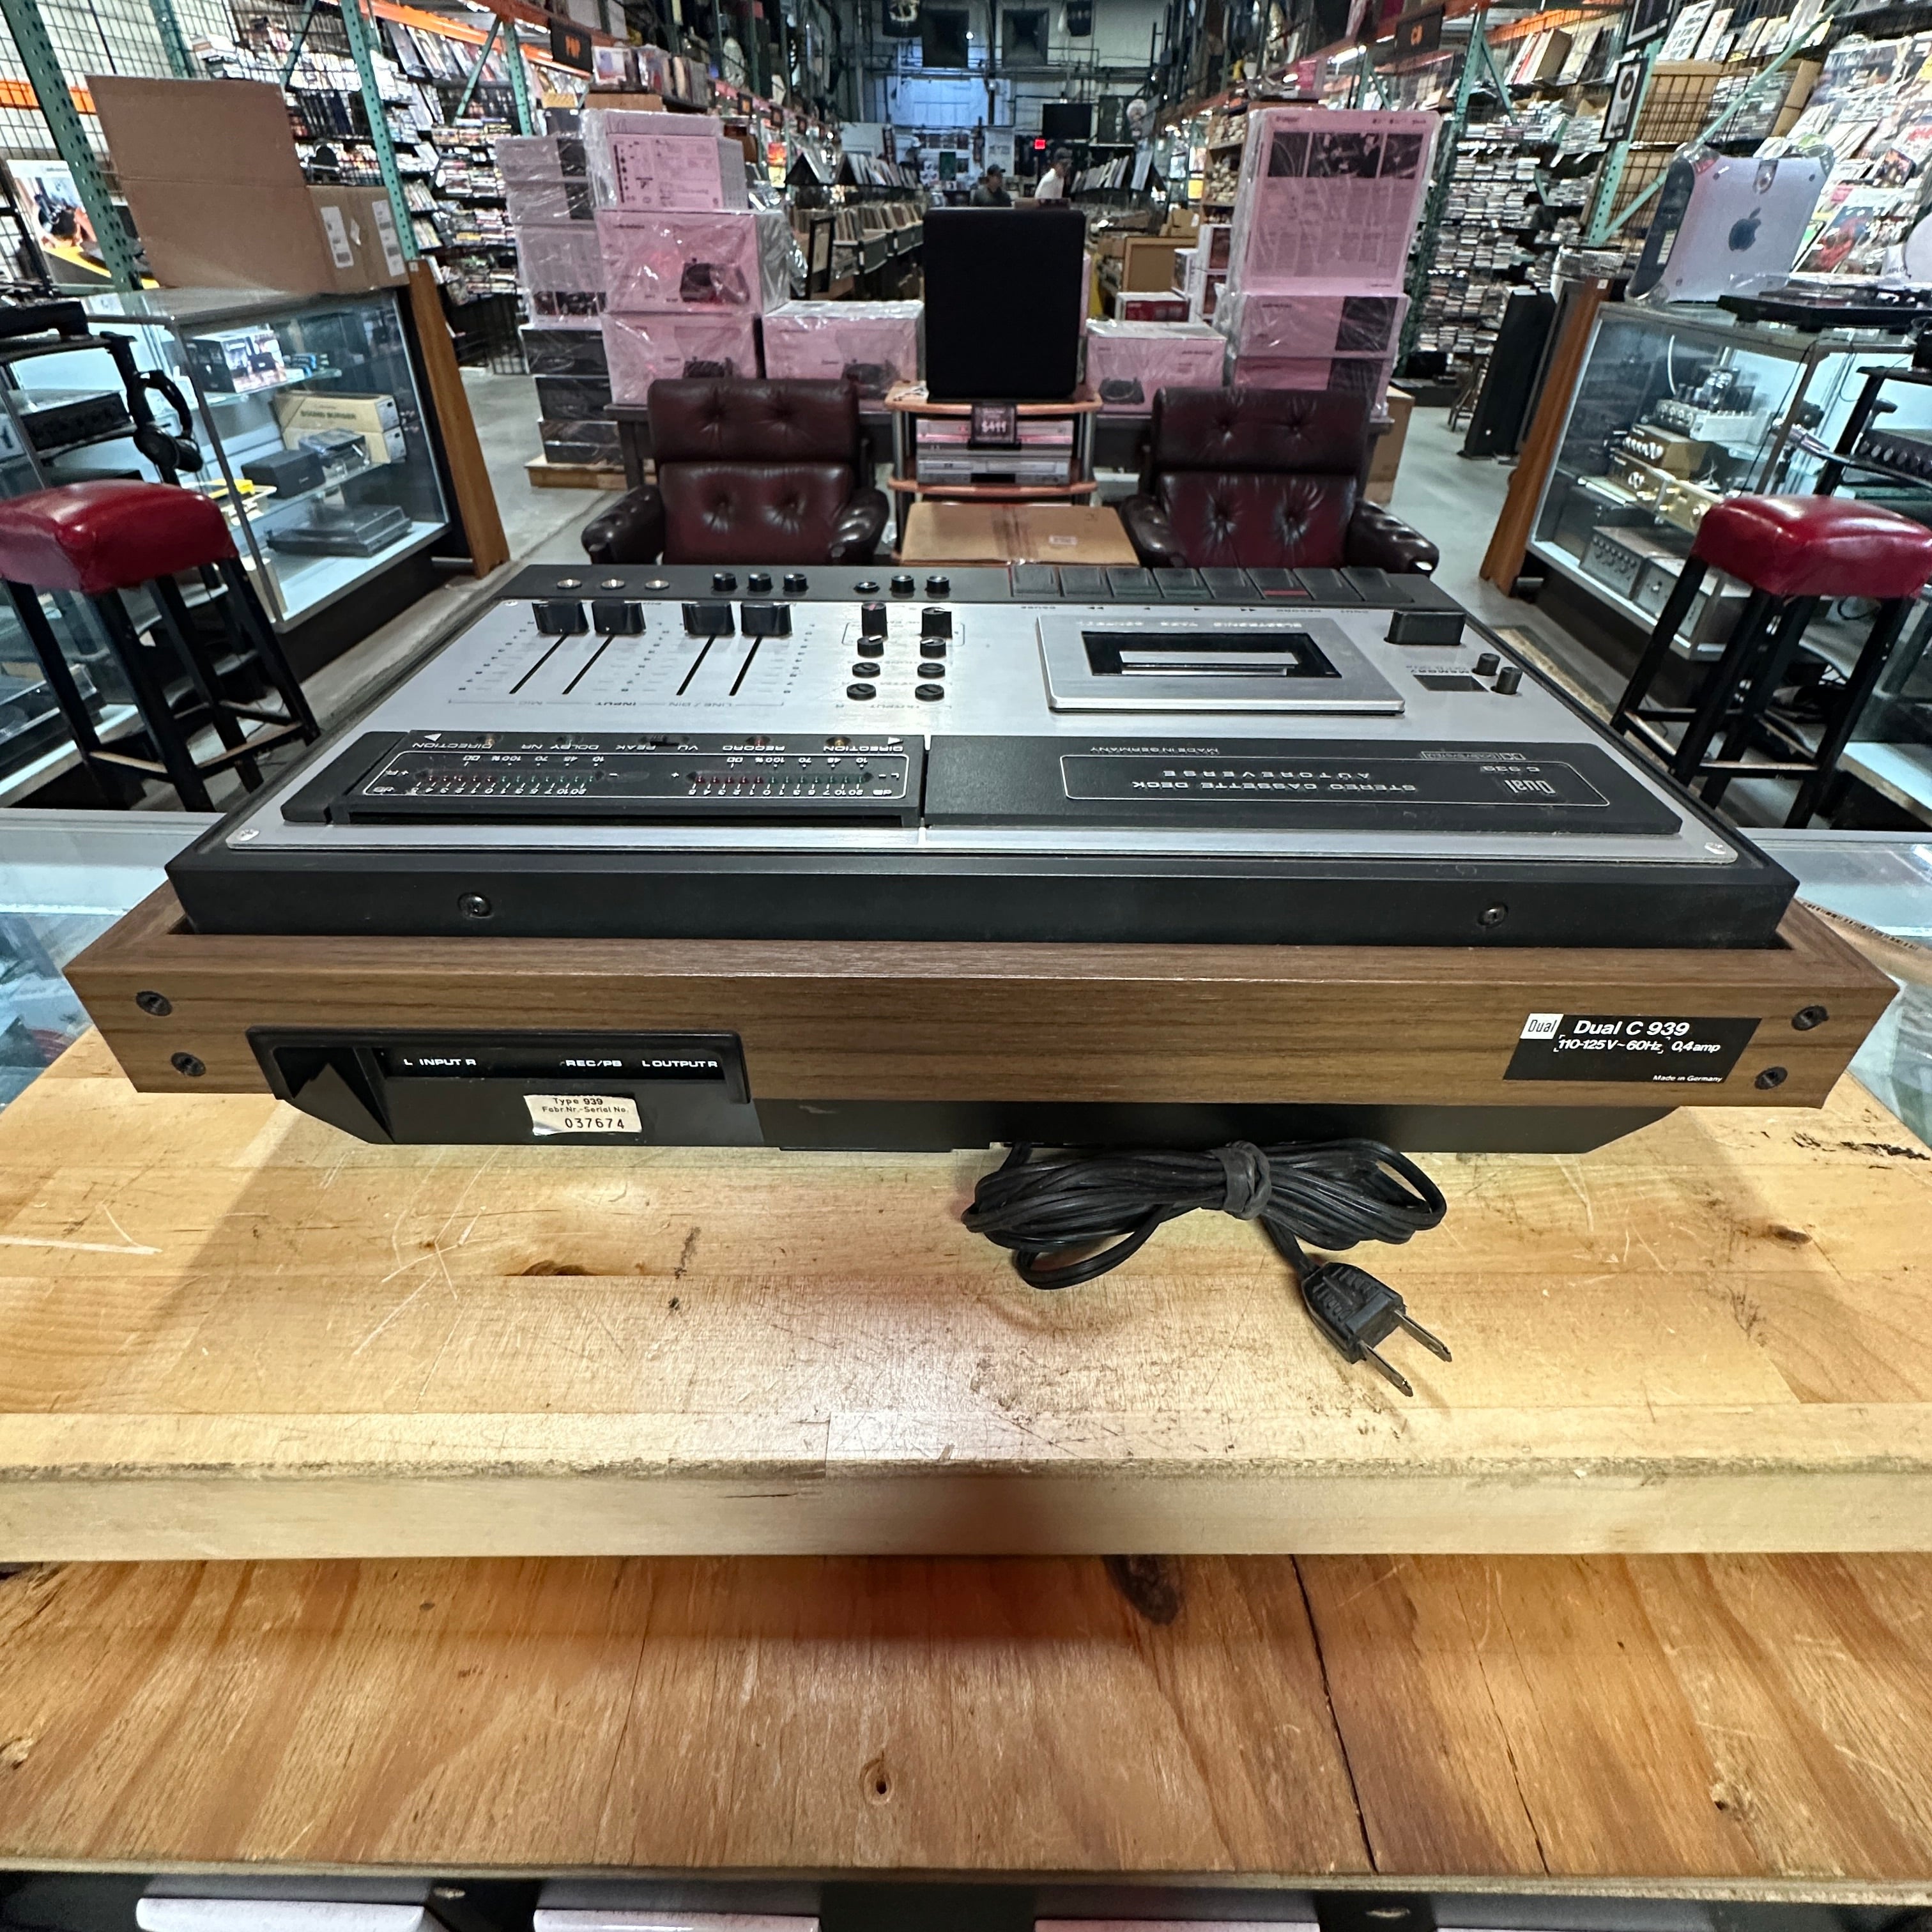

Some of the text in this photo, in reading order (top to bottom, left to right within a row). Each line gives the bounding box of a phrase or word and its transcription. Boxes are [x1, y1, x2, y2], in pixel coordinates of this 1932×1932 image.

[1162, 770, 1370, 779] AUTOREVERSE
[1131, 781, 1189, 789] DECK
[1200, 781, 1317, 790] CASSETTE
[1504, 779, 1556, 794] Dual
[1528, 1018, 1558, 1032] Dual
[1573, 1020, 1690, 1036] Dual C 939
[419, 1058, 462, 1066] INPUT
[1686, 1075, 1724, 1083] Germany
[553, 1097, 579, 1105] Type
[564, 1117, 625, 1130] 037674
